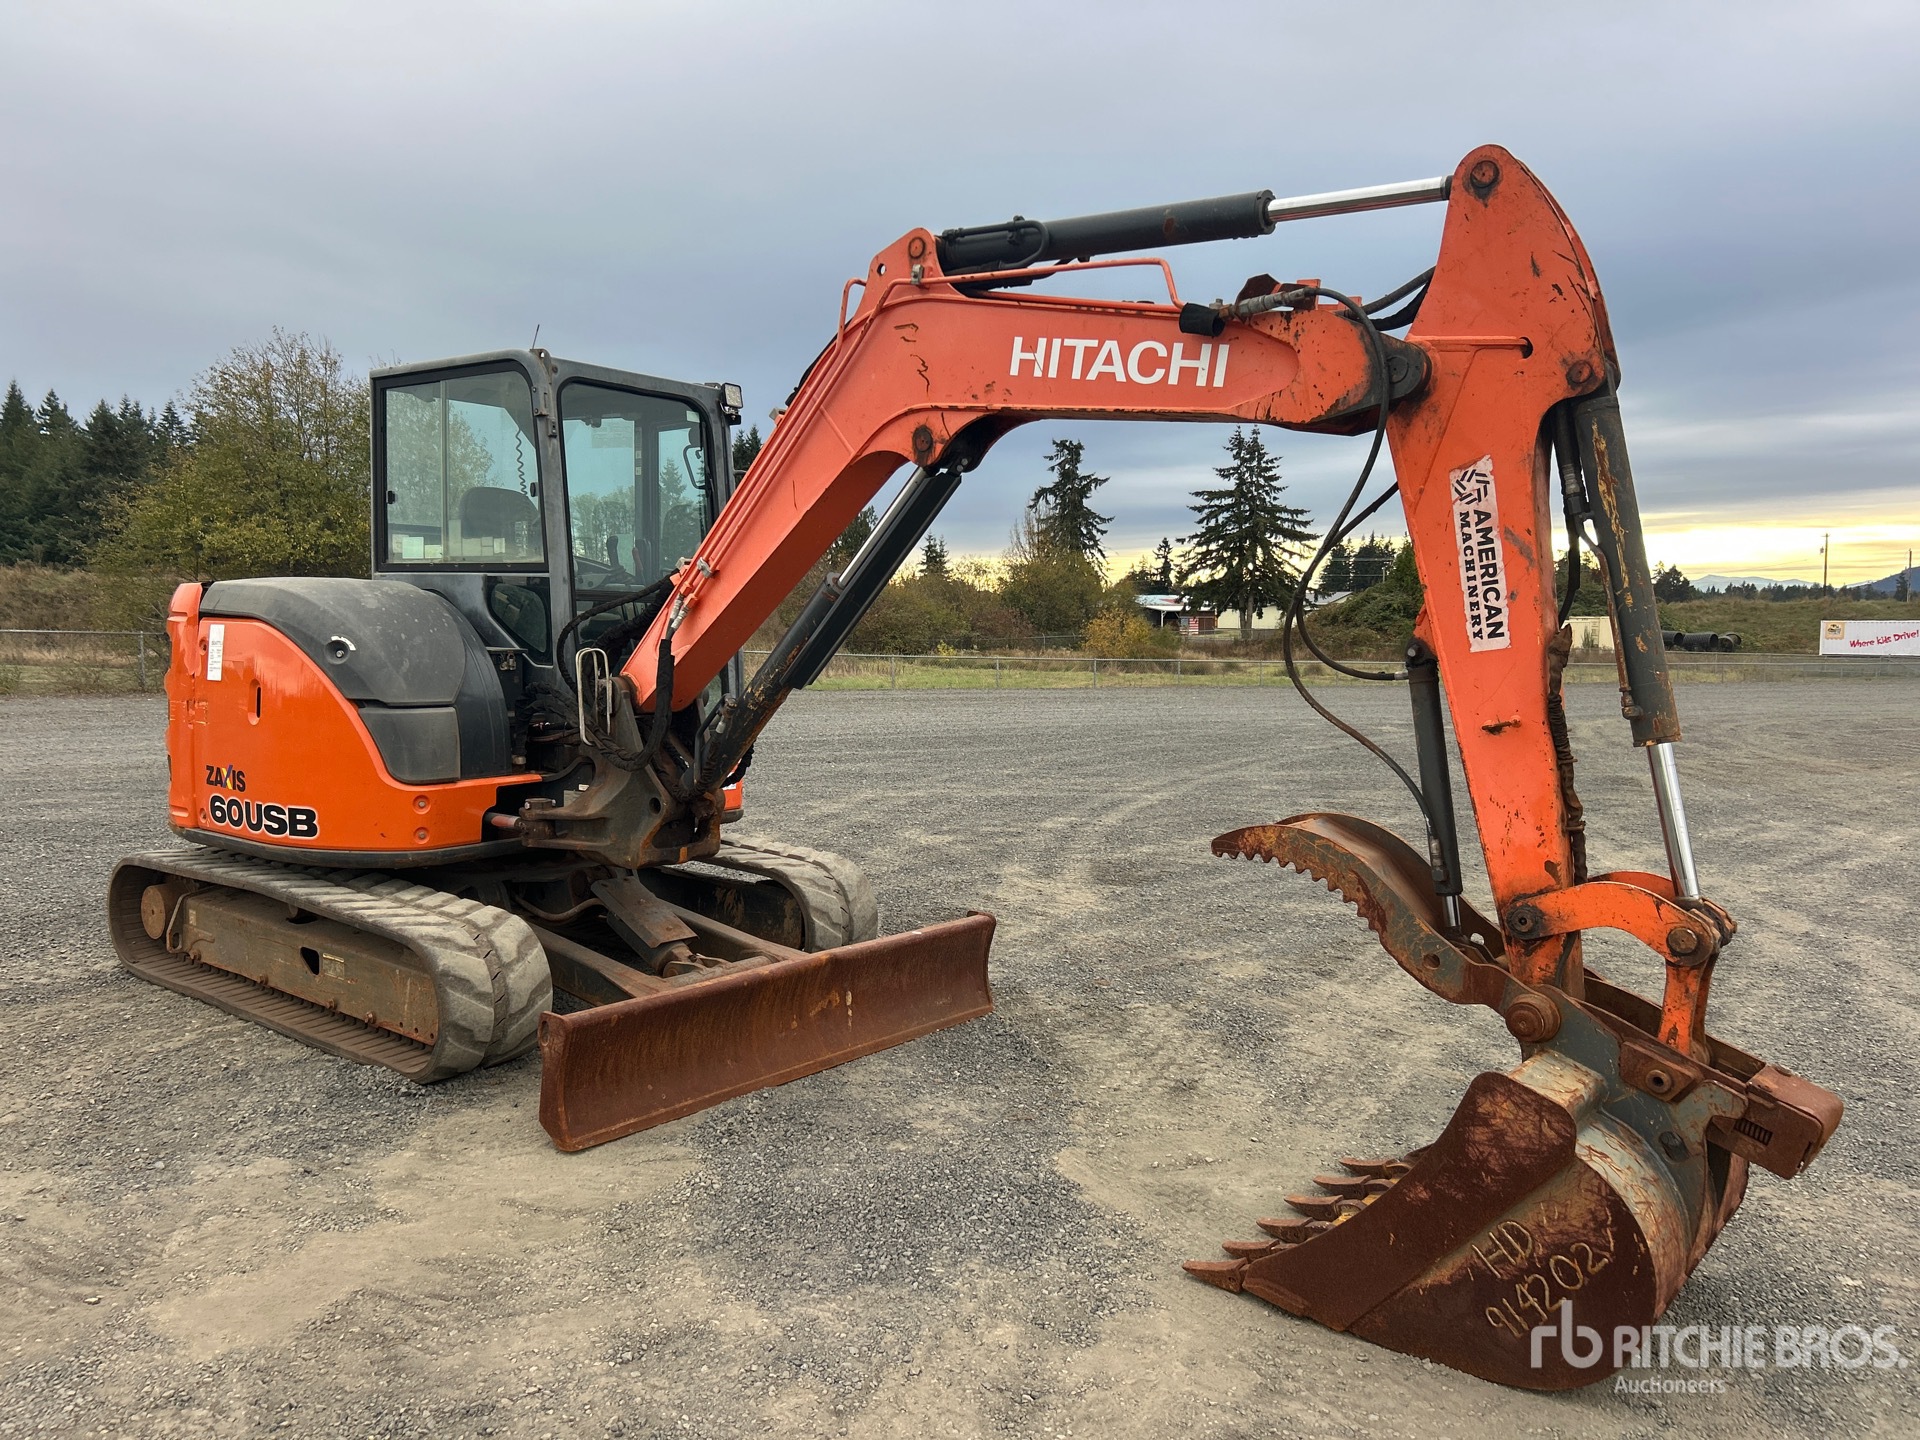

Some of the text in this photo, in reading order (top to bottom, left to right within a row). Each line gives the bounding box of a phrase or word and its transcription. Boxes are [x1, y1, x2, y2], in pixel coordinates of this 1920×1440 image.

[1009, 336, 1230, 388] HITACHI
[1459, 511, 1484, 640] MACHINERY
[1473, 509, 1505, 640] AMERICAN
[1849, 639, 1875, 648] Where
[1893, 630, 1919, 642] Drive!
[205, 764, 246, 792] ZAXIS
[209, 795, 318, 838] 60USB
[1472, 1221, 1532, 1279] HD
